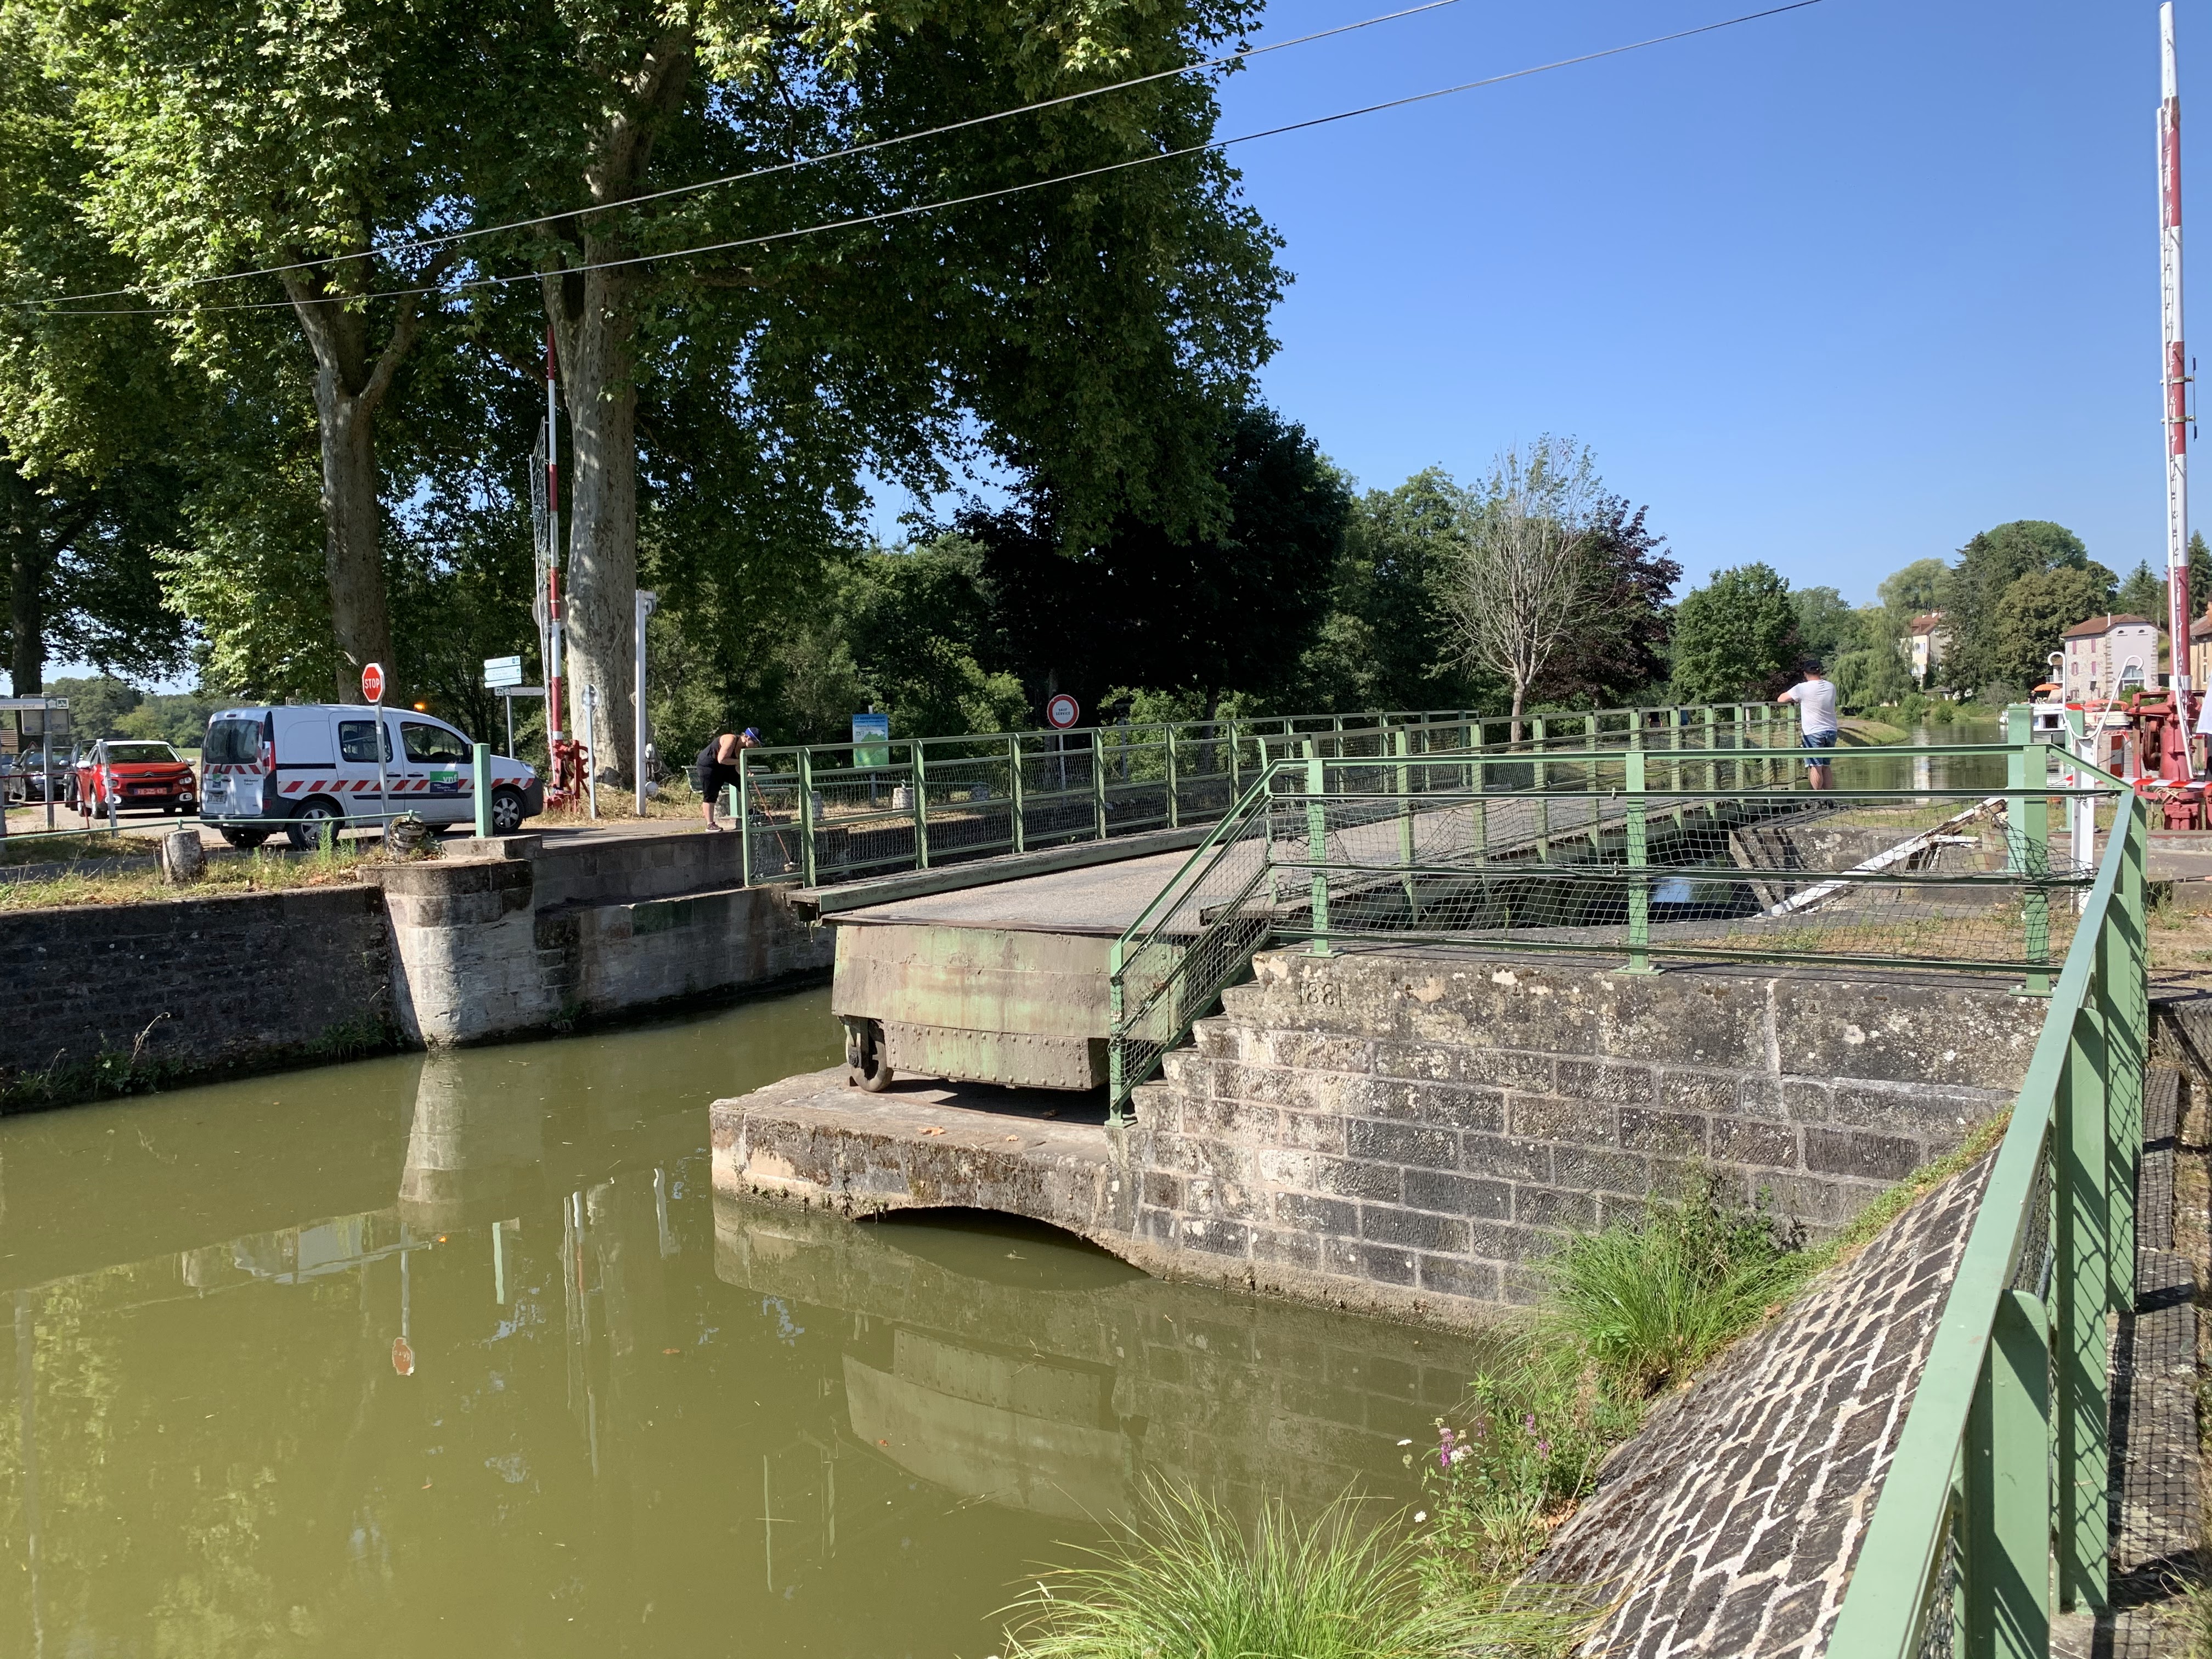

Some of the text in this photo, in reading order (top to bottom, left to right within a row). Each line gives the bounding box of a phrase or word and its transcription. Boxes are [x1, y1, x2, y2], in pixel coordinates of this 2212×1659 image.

[364, 678, 380, 689] STOP
[443, 774, 458, 783] vnf
[1299, 981, 1342, 1007] 1881
